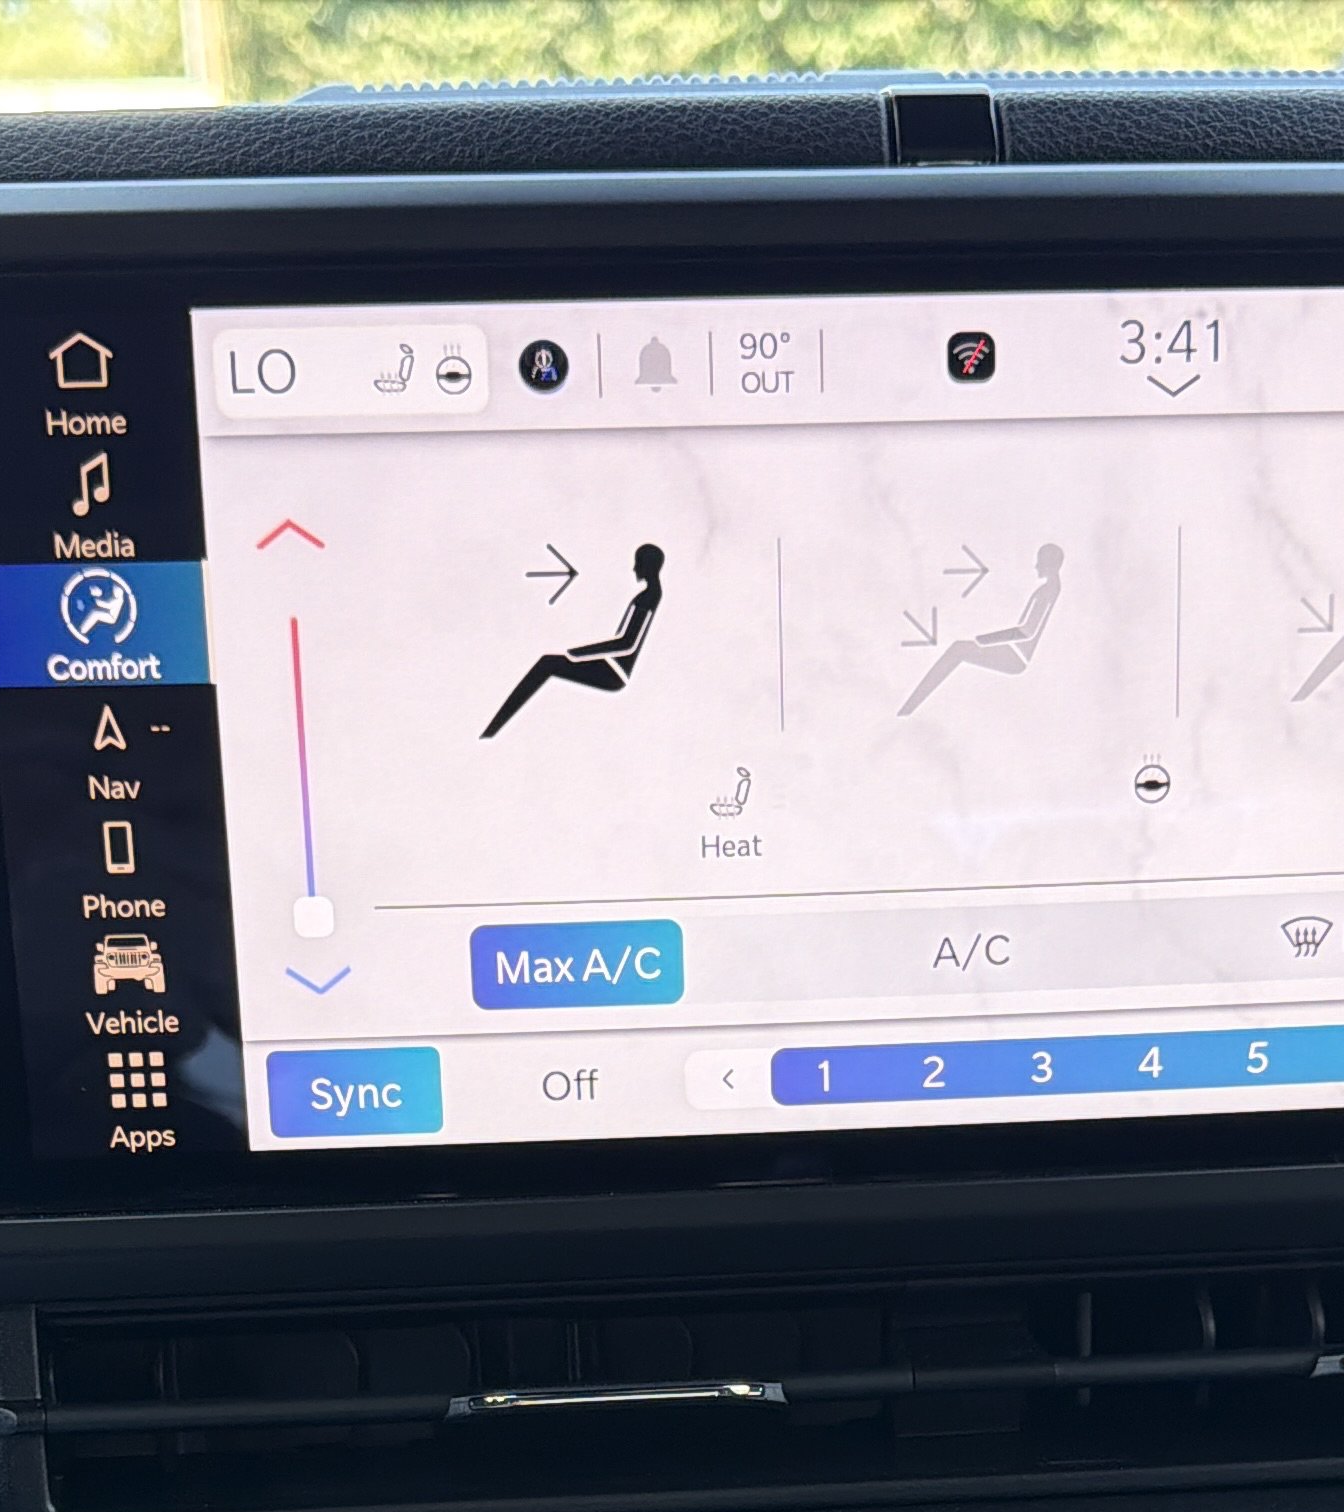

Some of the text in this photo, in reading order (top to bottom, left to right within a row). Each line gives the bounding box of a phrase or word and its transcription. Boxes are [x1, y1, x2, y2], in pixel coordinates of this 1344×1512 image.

[739, 331, 791, 361] 90°
[1119, 318, 1222, 366] 3:41
[228, 347, 298, 395] LO
[740, 370, 795, 395] OUT
[45, 408, 128, 437] Home
[53, 530, 136, 560] Media
[47, 651, 162, 682] Comfort
[88, 775, 141, 801] Nav
[700, 833, 762, 859] Heat
[82, 893, 167, 920] Phone
[495, 947, 662, 985] Max A/C
[932, 934, 1011, 970] A/C
[86, 1010, 179, 1036] Vehicle
[817, 1060, 831, 1092] 1
[922, 1057, 946, 1088] 2
[1031, 1052, 1053, 1084] 3
[1138, 1046, 1163, 1078] 4
[1247, 1043, 1269, 1073] 5
[309, 1077, 403, 1116] Sync
[542, 1067, 599, 1103] Off
[110, 1125, 176, 1152] Apps
